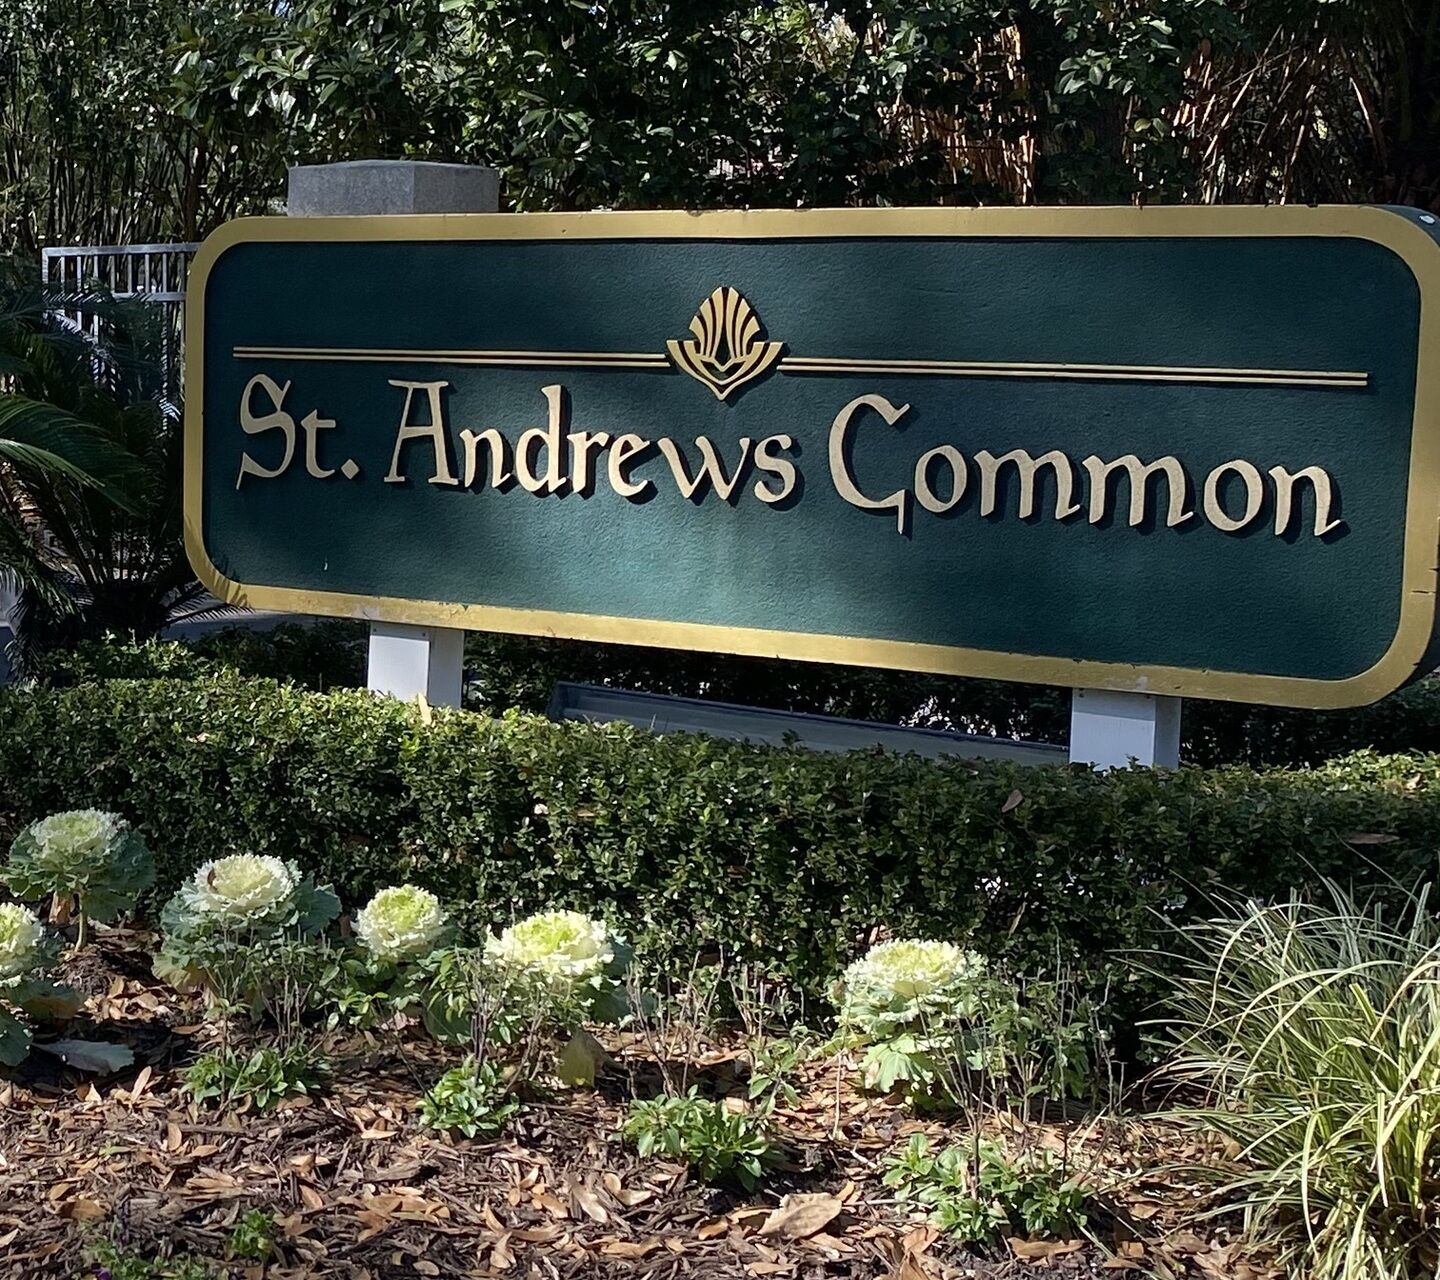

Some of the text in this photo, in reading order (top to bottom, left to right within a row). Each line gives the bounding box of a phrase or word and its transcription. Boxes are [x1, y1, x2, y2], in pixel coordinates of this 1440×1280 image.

[235, 373, 1343, 537] St. Andrews Common
